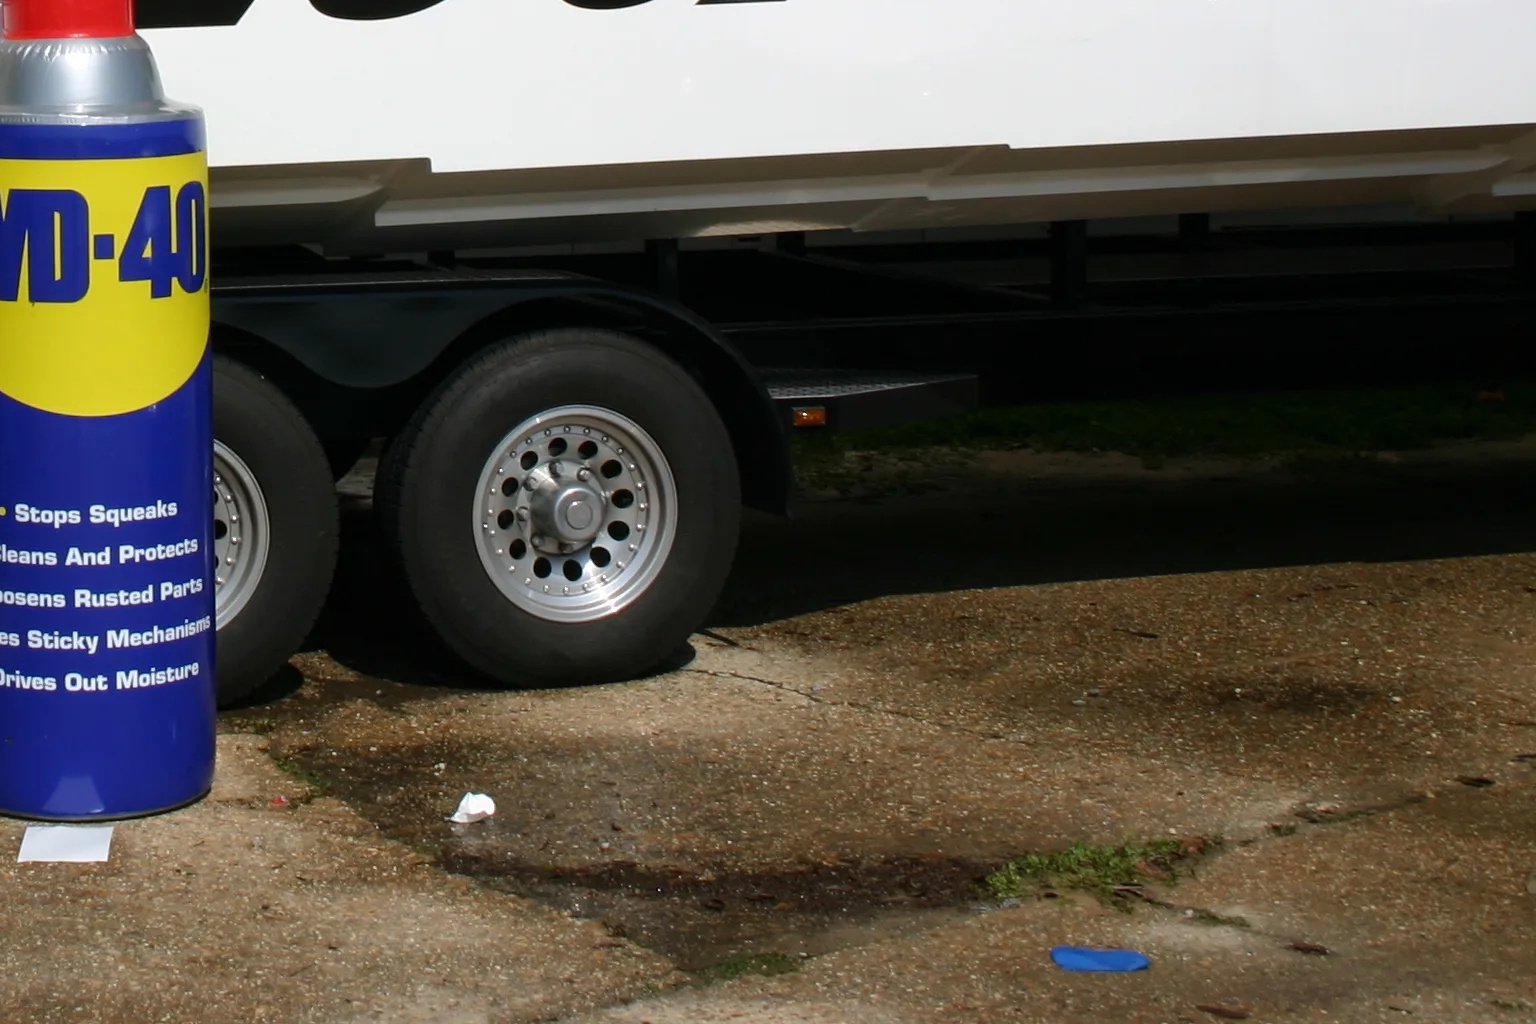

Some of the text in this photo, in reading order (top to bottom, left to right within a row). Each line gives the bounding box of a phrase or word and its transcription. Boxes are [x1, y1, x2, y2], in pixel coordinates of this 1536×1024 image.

[14, 499, 179, 529] Stops Squeaks
[65, 546, 112, 567] And
[118, 537, 199, 565] Protects
[74, 585, 154, 609] Rusted
[160, 577, 204, 602] Parts
[26, 629, 99, 655] Sticky
[106, 614, 212, 650] Mechanisms
[64, 672, 109, 693] Out
[115, 661, 200, 691] Moisture
